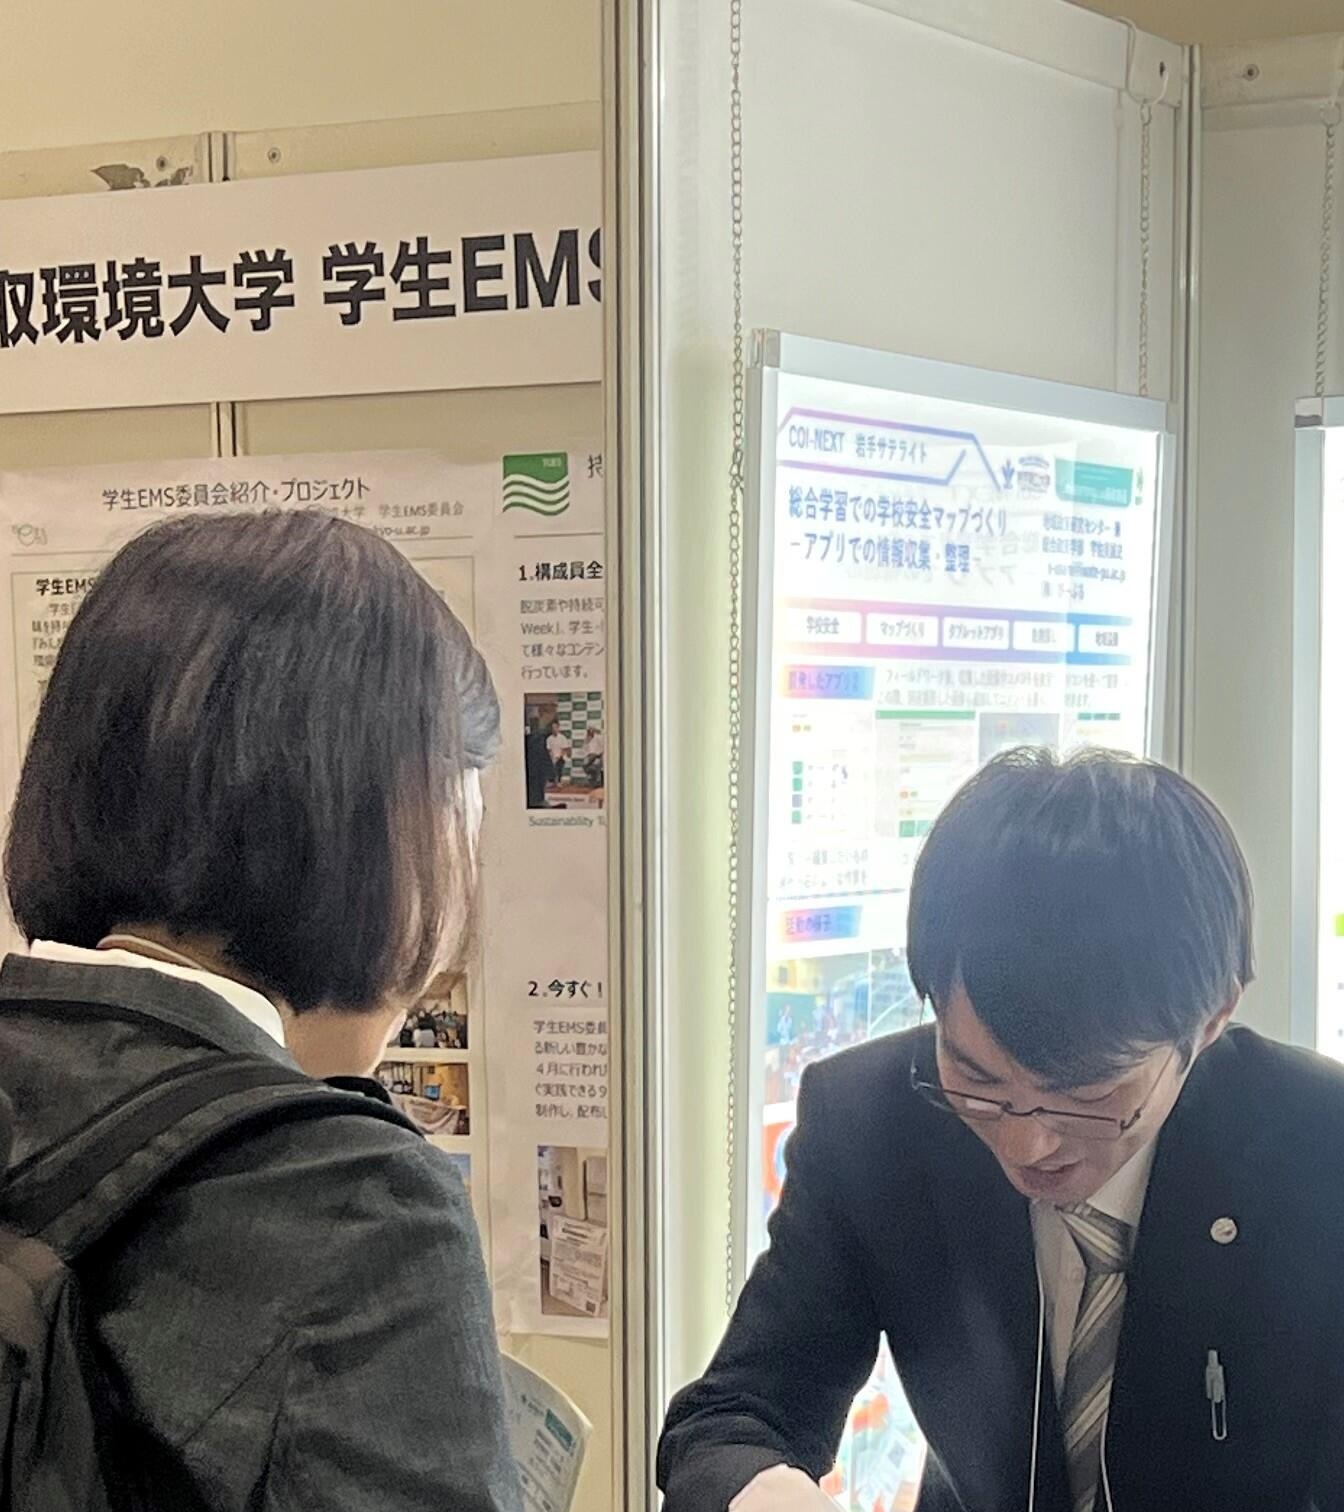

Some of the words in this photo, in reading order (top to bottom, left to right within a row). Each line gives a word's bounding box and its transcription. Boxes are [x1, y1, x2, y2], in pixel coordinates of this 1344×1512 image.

[788, 425, 845, 452] COI-NEXT
[855, 432, 929, 461] 岩手サテライト
[101, 477, 372, 512] 学生EMS委員会紹介・プロジェクト
[788, 486, 1008, 537] 総合学習での学校安全マップづくり
